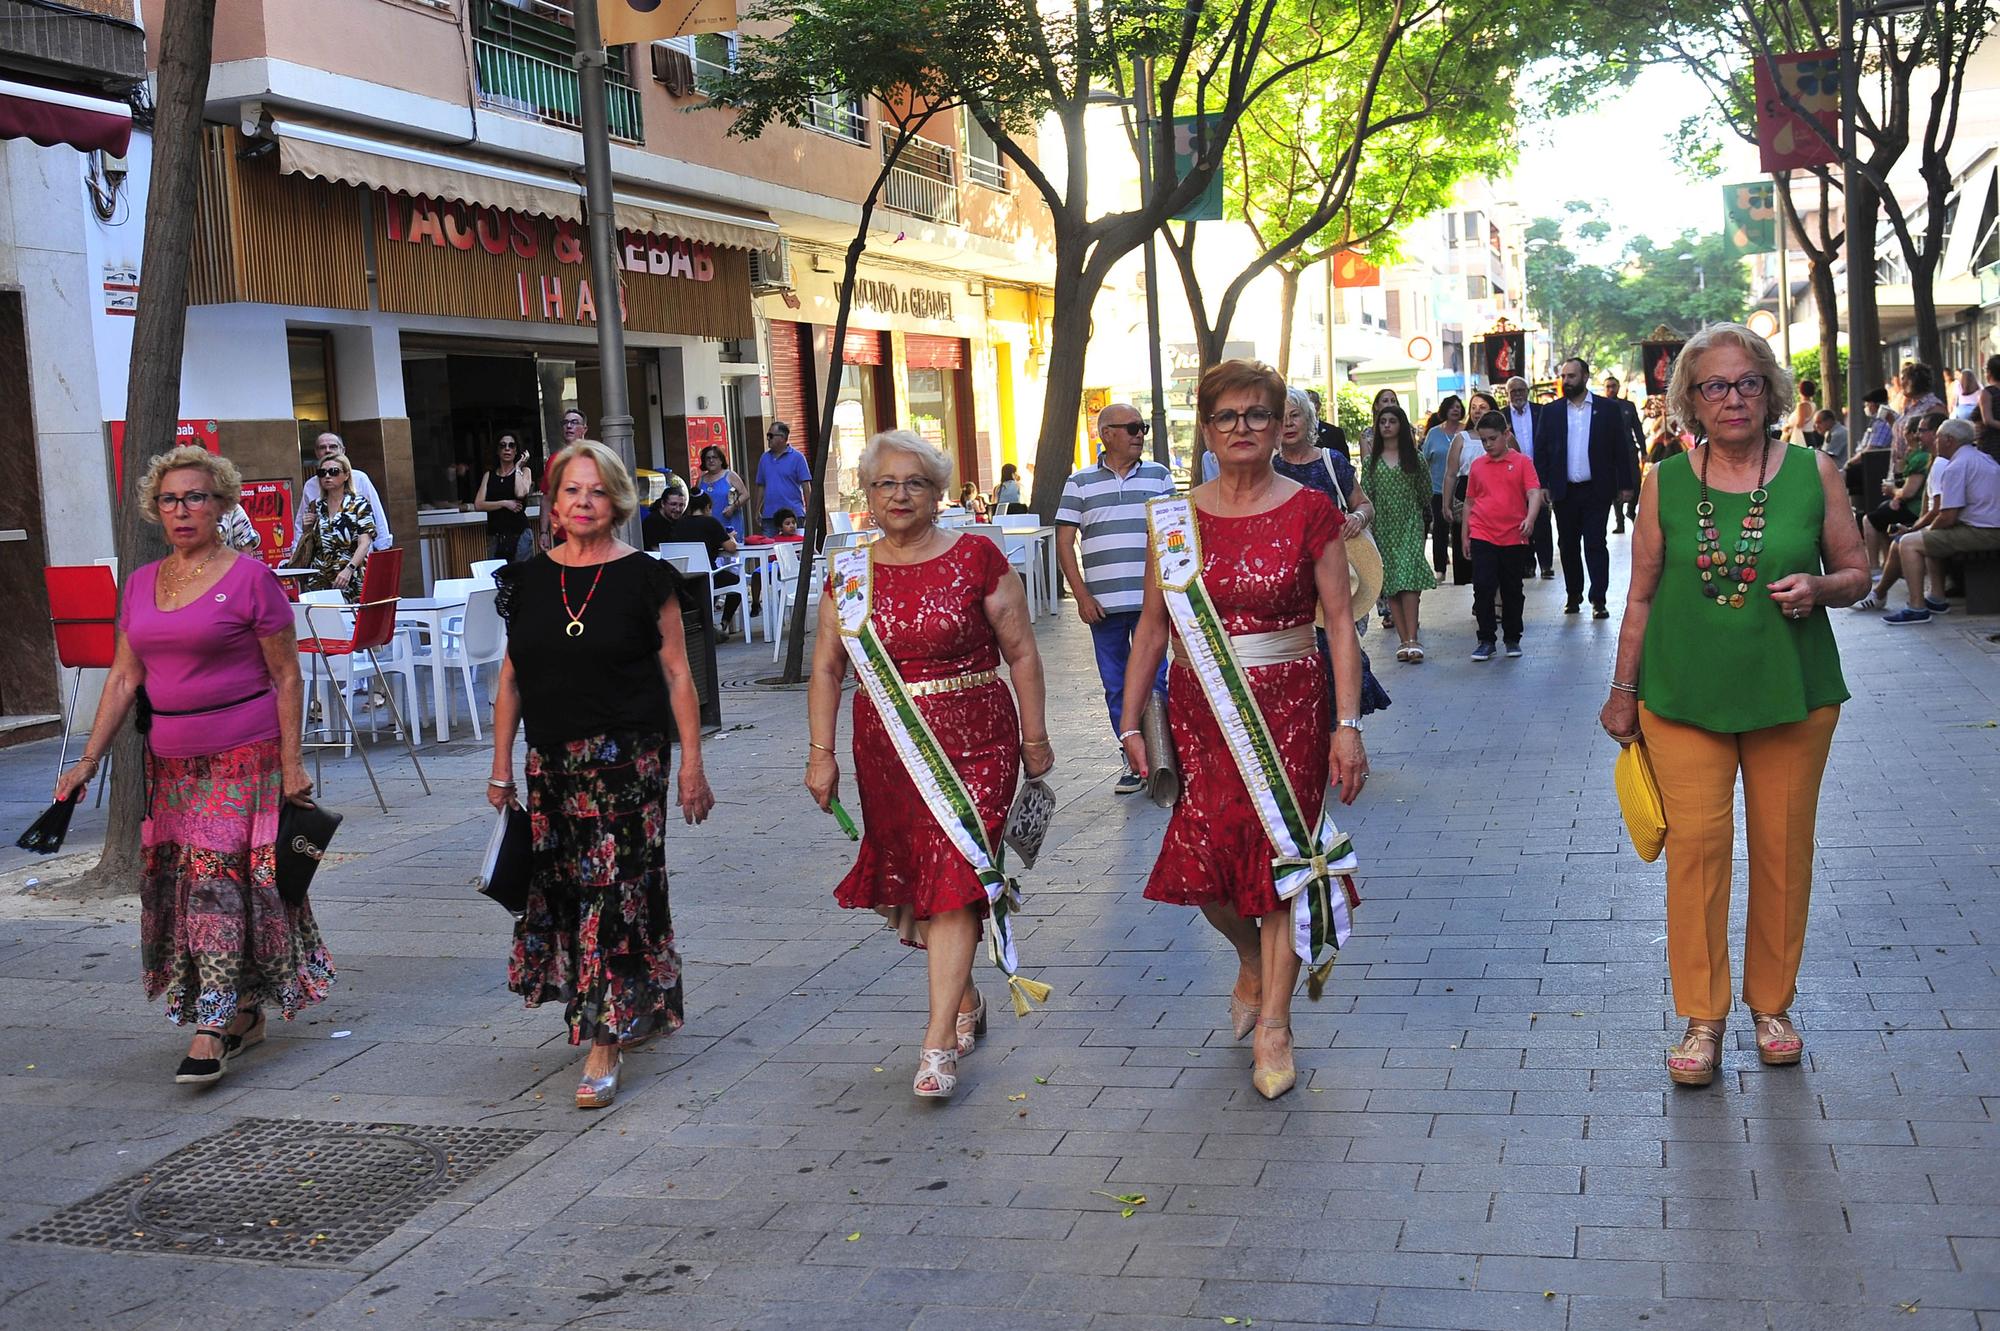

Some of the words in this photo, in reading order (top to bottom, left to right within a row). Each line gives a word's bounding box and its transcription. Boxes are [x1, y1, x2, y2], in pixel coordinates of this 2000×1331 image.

[379, 190, 539, 259] TACOS
[617, 229, 714, 282] EBAB
[518, 271, 627, 323] IHA
[853, 278, 899, 314] MUNDO
[910, 287, 955, 322] GRANEL
[1187, 612, 1227, 671] DAMA
[1229, 707, 1277, 791] MAYORES
